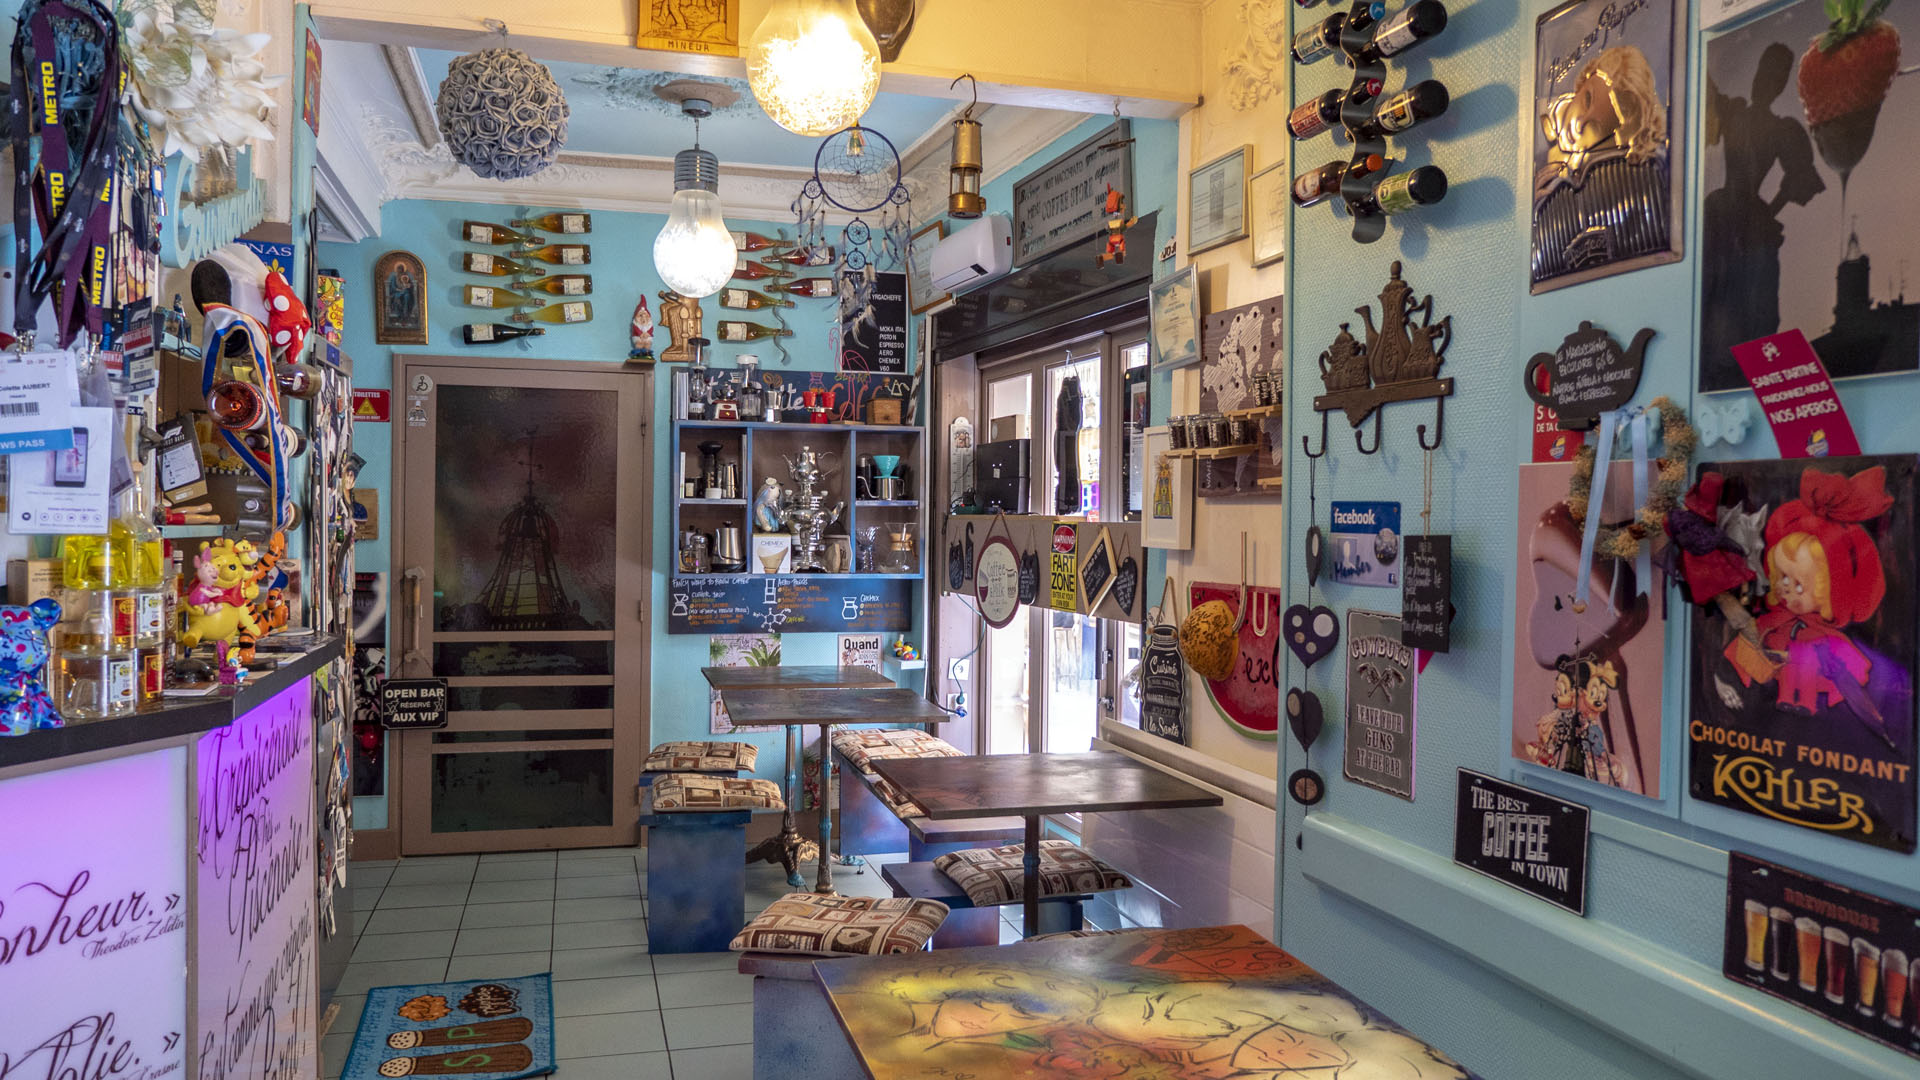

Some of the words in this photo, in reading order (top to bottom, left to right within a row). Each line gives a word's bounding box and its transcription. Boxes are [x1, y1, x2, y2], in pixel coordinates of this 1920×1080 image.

[41, 61, 59, 125] METRO
[92, 246, 105, 305] METRO
[1769, 408, 1796, 424] NOS
[18, 439, 46, 448] PASS
[1334, 508, 1376, 524] facebook
[1054, 536, 1076, 544] WARNING
[1052, 554, 1074, 574] FART
[1052, 572, 1074, 592] ZONE
[844, 638, 878, 650] Quand
[1351, 635, 1411, 668] COWBOYS
[385, 688, 417, 698] OPEN
[420, 688, 444, 698] BAR
[392, 712, 416, 722] AUX
[420, 712, 440, 721] VIP
[1356, 704, 1380, 728] LEAVE
[1380, 710, 1404, 734] YOUR
[1365, 728, 1394, 752] GUNS
[1690, 720, 1786, 757] CHOCOLAT
[1797, 745, 1910, 783] FONDANT
[1356, 748, 1366, 766] AT
[1367, 751, 1384, 773] THE
[1384, 756, 1401, 778] BAR
[1471, 786, 1495, 809] THE
[1496, 794, 1530, 812] BEST
[1713, 754, 1873, 834] KOHLER
[1482, 811, 1551, 862] COFFEE
[1512, 861, 1526, 874] IN
[1528, 863, 1568, 892] TOWN
